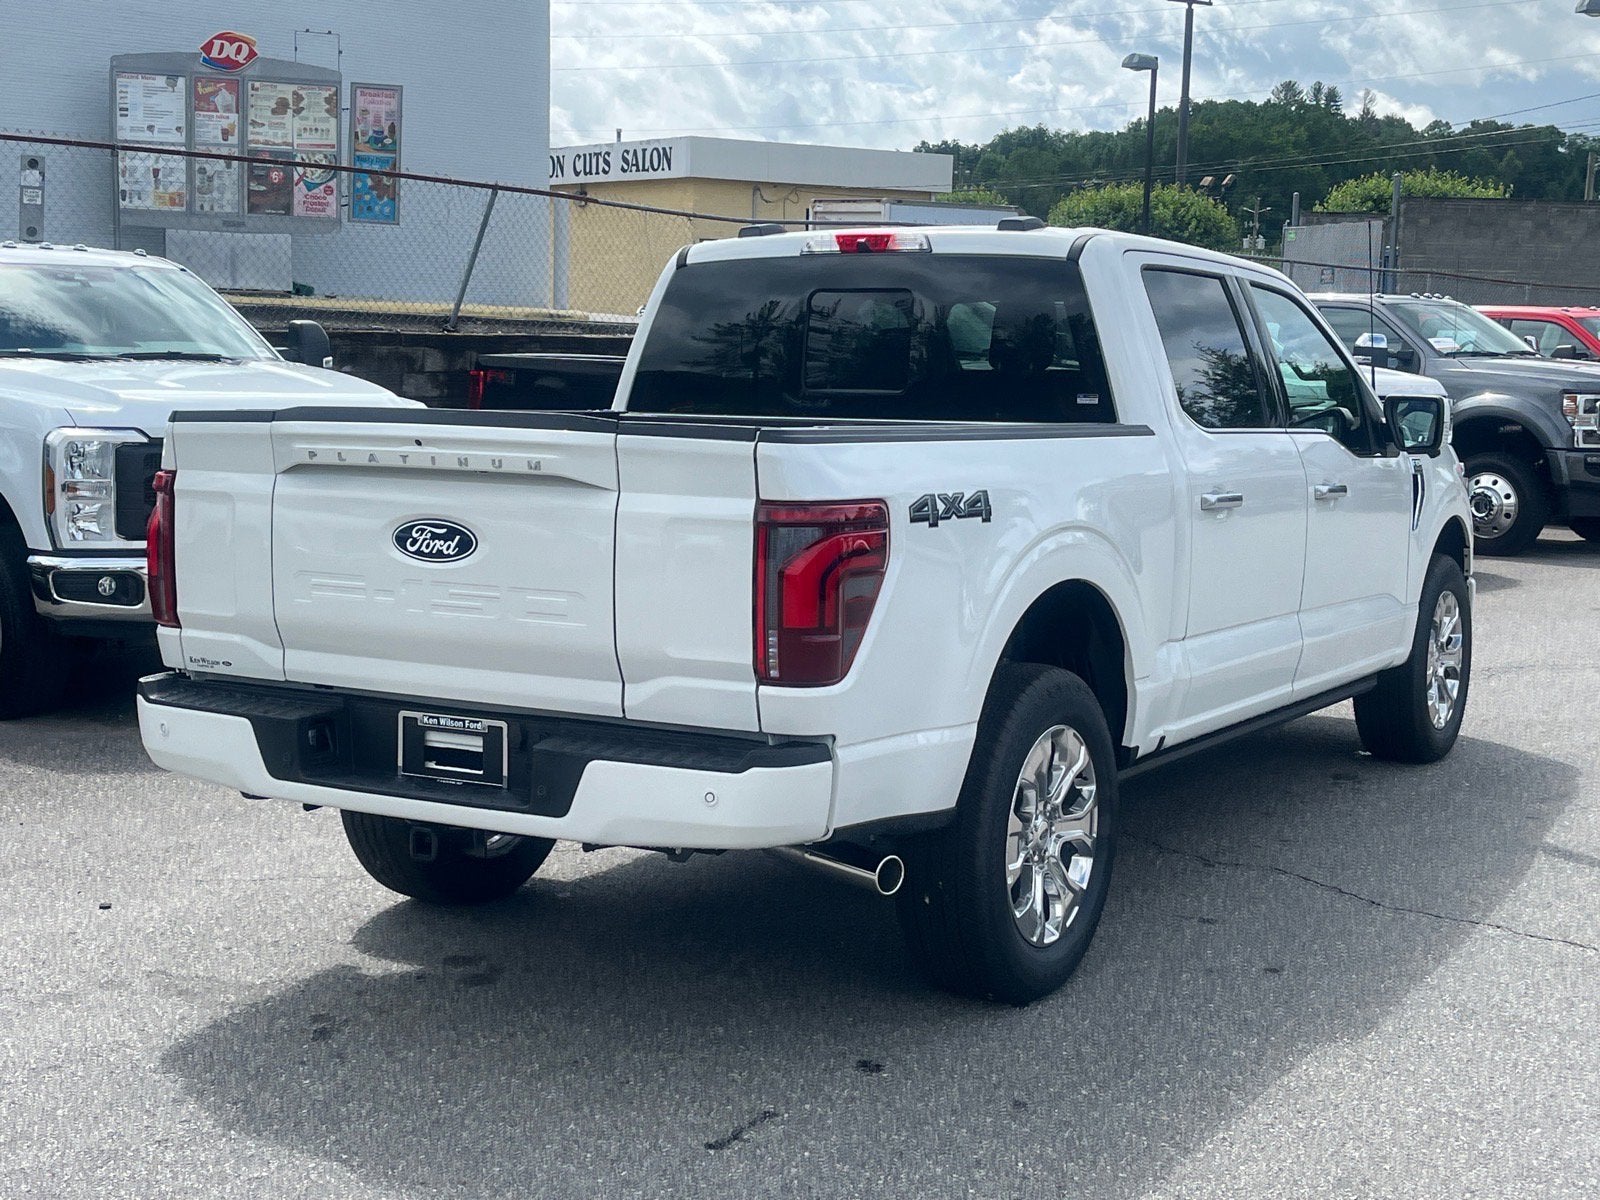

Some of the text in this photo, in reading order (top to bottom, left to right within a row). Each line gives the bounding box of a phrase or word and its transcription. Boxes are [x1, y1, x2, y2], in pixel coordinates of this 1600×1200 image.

[209, 39, 250, 64] DQ
[573, 151, 611, 177] CUTS
[620, 146, 672, 173] SALON
[304, 193, 327, 201] Choco
[308, 451, 541, 471] PLATINUM
[406, 525, 460, 555] Ford
[423, 715, 482, 729] Ken Wilson Ford
